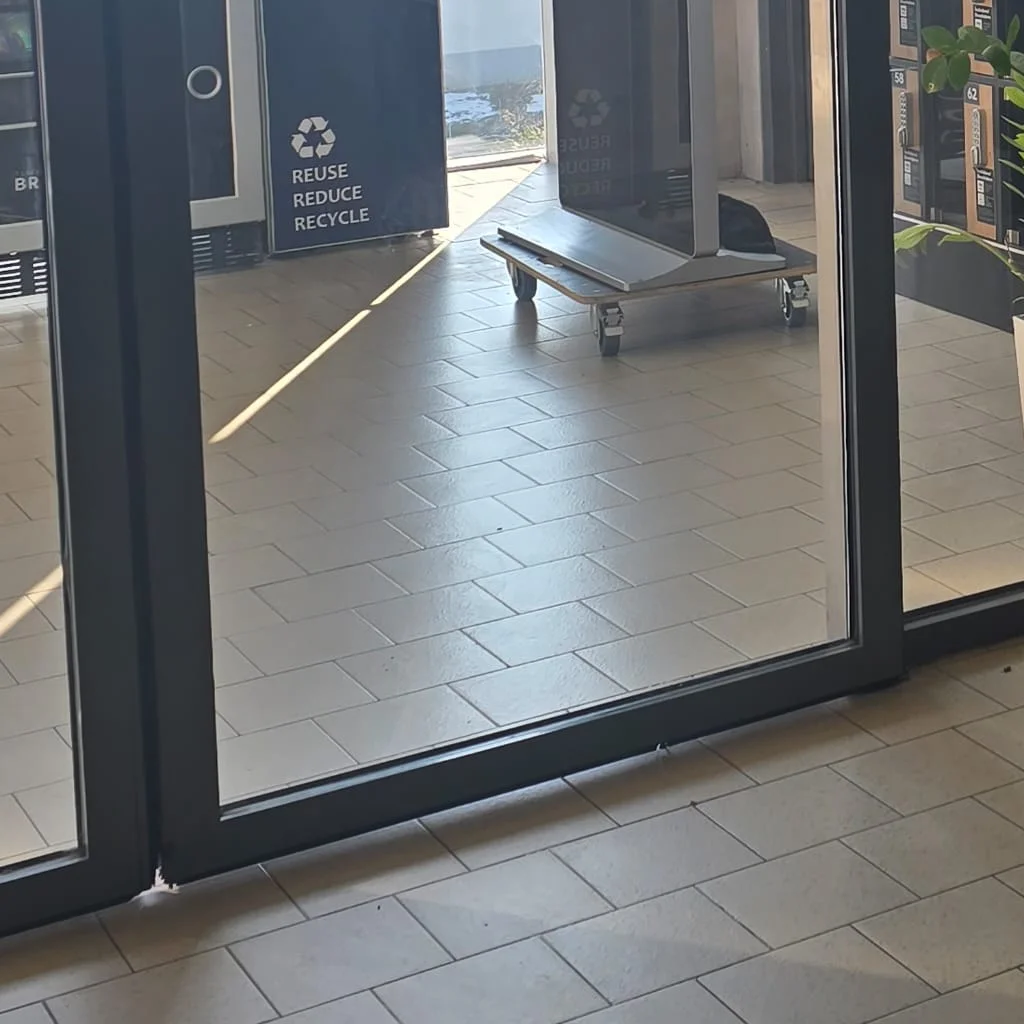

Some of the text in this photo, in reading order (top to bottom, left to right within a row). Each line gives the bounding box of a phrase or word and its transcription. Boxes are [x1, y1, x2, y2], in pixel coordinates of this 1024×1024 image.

[967, 87, 978, 100] 62
[292, 163, 349, 184] REUSE
[293, 185, 363, 208] REDUCE
[294, 207, 370, 231] RECYCLE
